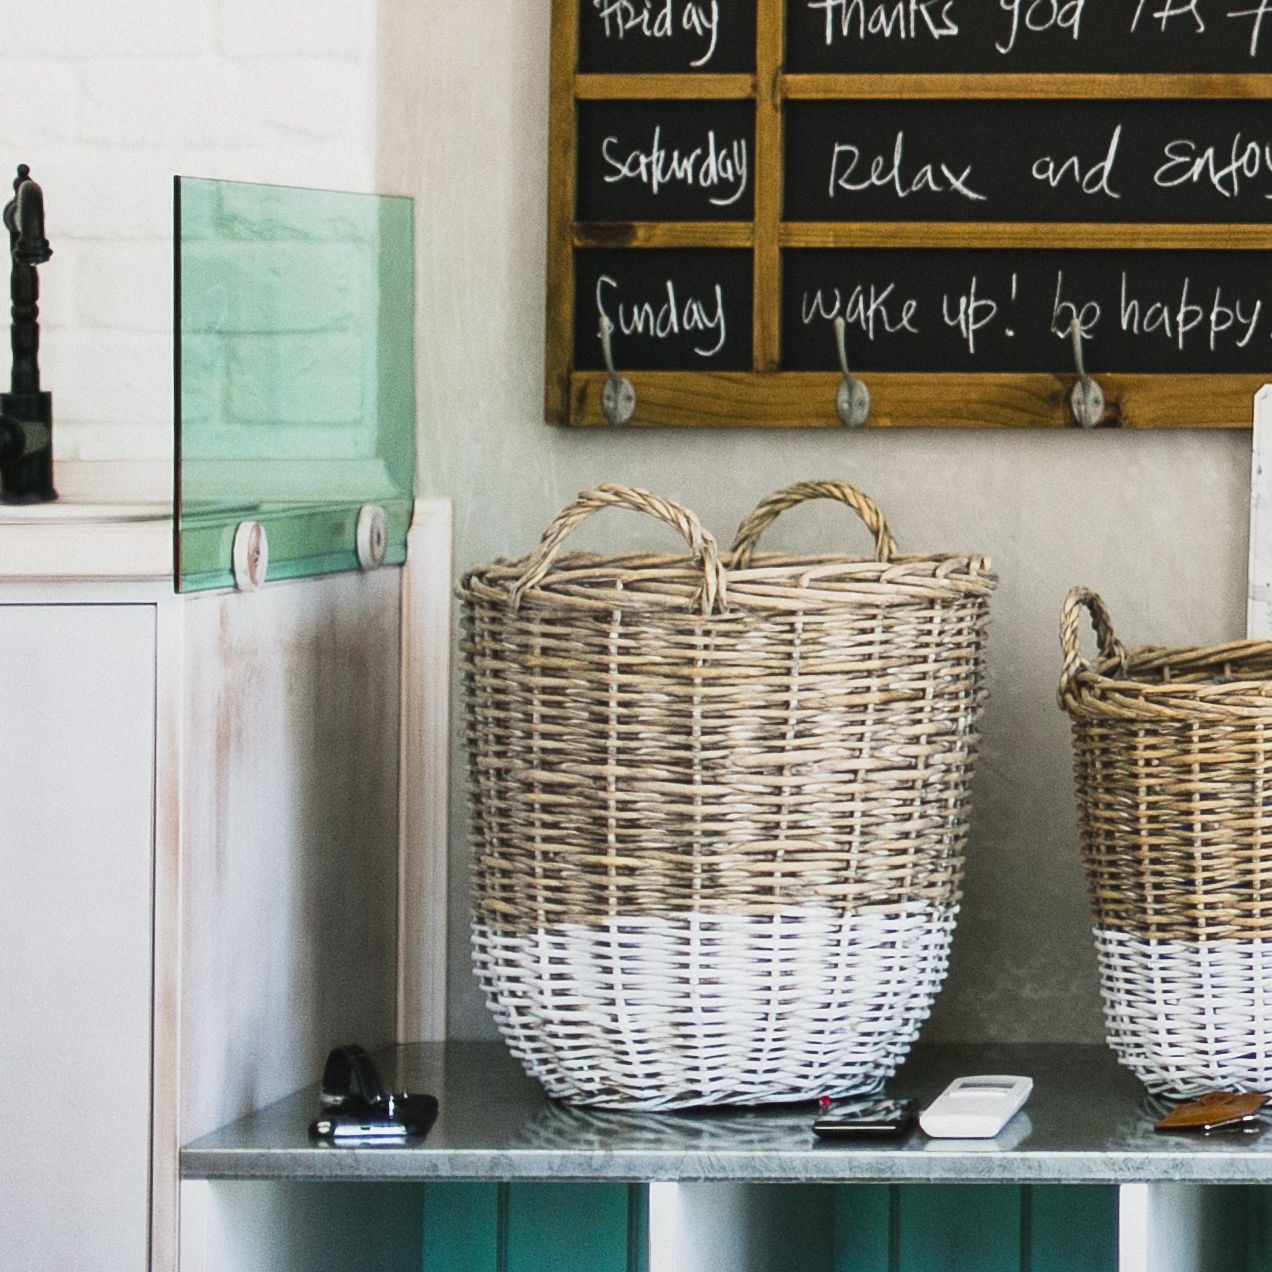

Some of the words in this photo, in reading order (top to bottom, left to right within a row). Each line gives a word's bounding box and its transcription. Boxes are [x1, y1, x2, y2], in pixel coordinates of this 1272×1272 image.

[602, 125, 747, 206] Saturday
[828, 131, 987, 201] Relax
[1031, 124, 1122, 199] and
[594, 273, 727, 358] Sunday
[800, 280, 920, 340] wake
[1050, 269, 1101, 340] be
